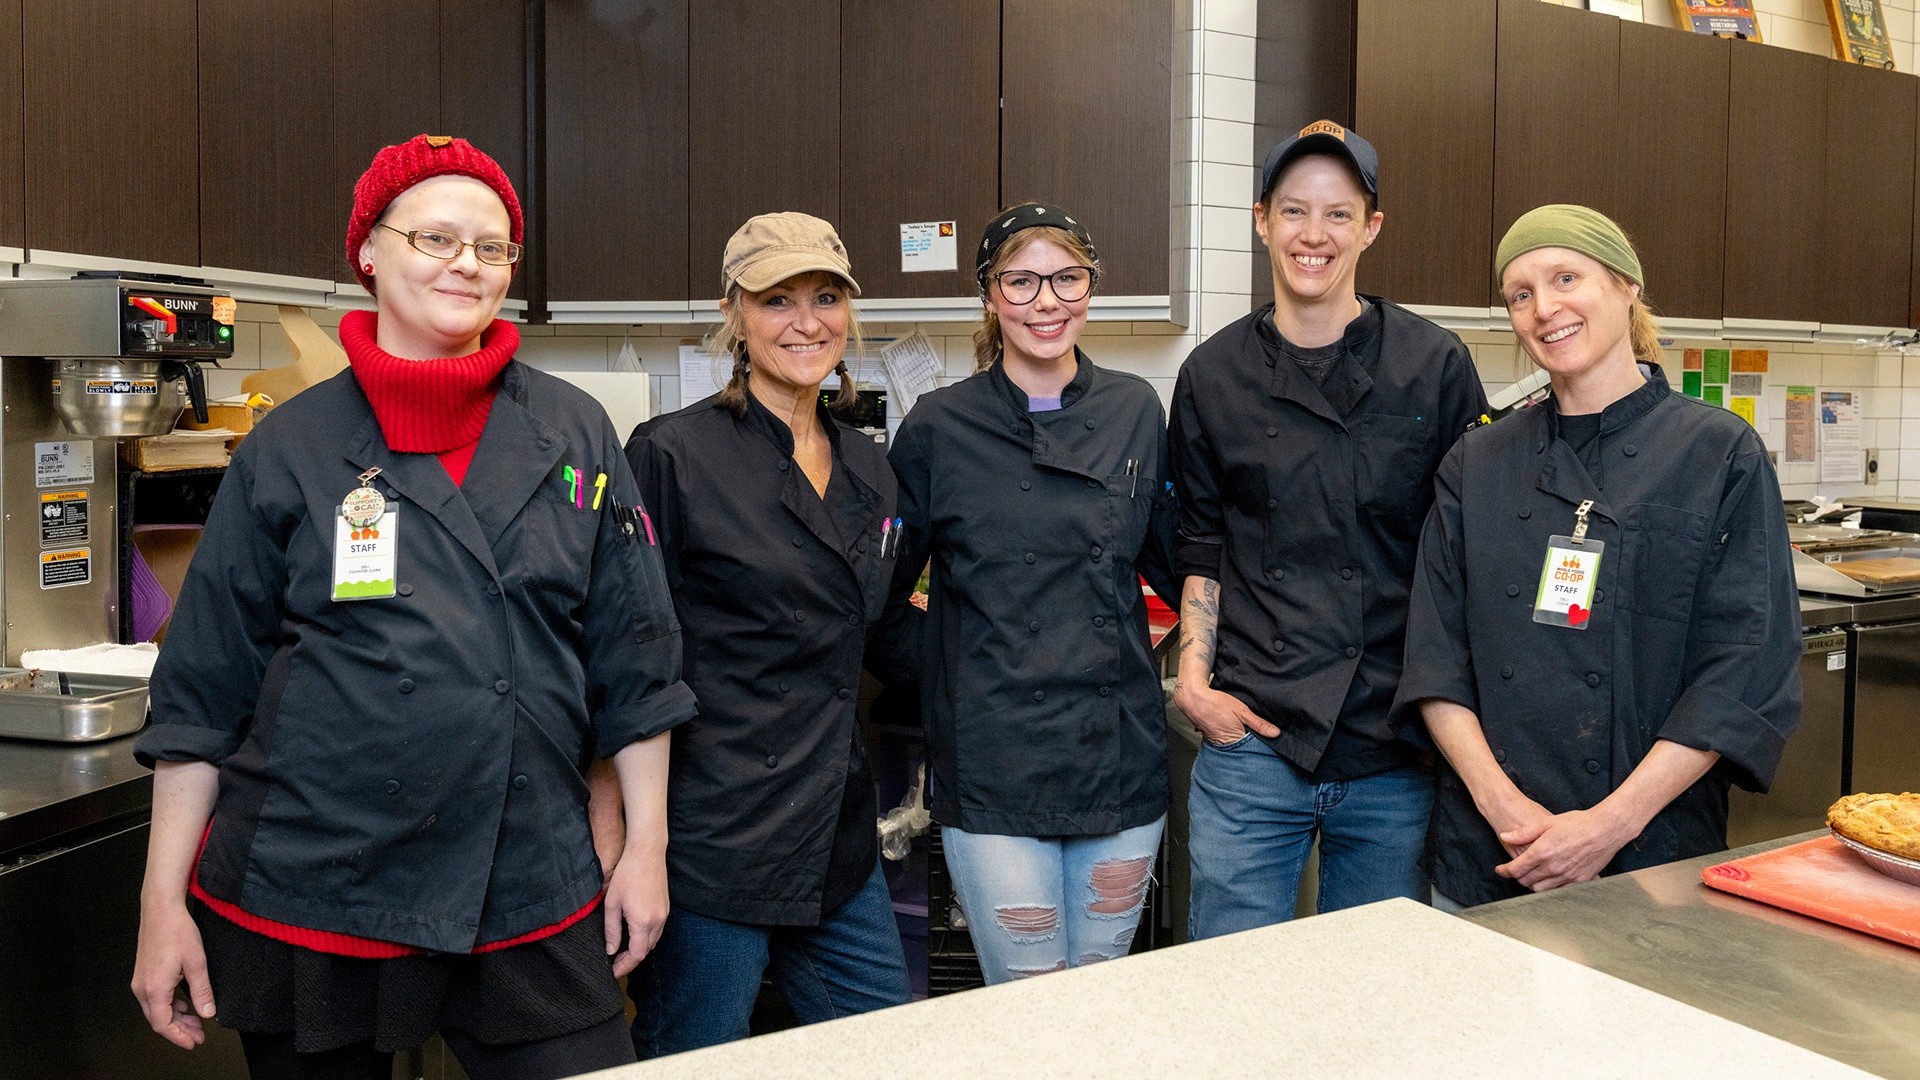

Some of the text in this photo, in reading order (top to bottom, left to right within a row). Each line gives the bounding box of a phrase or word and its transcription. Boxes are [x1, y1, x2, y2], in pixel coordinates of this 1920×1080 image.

[164, 299, 196, 311] BUNN
[351, 543, 377, 553] STAFF
[57, 552, 81, 560] WARNING
[1554, 584, 1578, 594] STAFF
